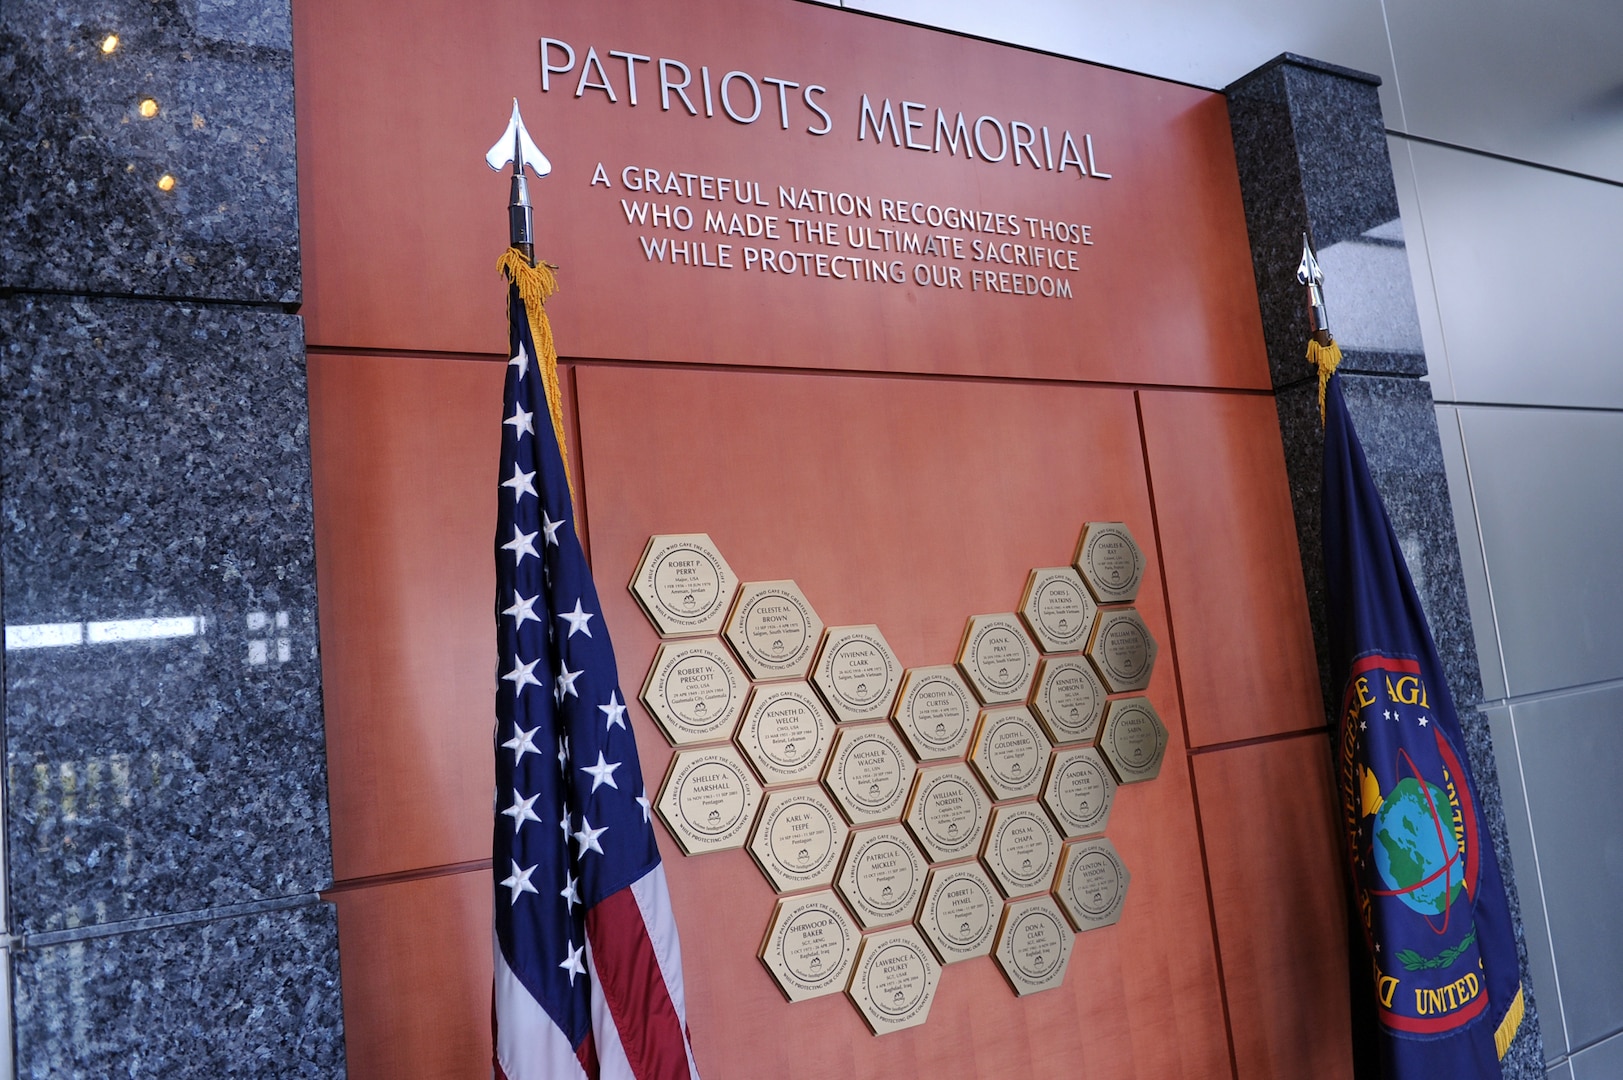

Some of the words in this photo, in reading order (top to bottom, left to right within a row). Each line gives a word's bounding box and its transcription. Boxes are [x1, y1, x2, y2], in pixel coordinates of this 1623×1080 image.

[540, 37, 833, 135] PATRIOTS
[858, 93, 1112, 179] MEMORIAL
[591, 162, 611, 188] A
[621, 165, 769, 206] GRATEFUL
[779, 185, 872, 218] NATION
[880, 198, 1020, 236] RECOGNIZES
[1024, 217, 1093, 246] THOSE
[620, 198, 694, 231] WHO
[704, 209, 780, 239] MADE
[788, 218, 840, 246] THE
[847, 225, 965, 259] ULTIMATE
[972, 240, 1080, 271] SACRIFICE
[639, 236, 733, 268] WHILE
[743, 247, 906, 283] PROTECTING
[914, 263, 963, 289] OUR
[972, 269, 1073, 299] FREEDOM
[680, 674, 714, 683] PRESCOTT
[767, 709, 797, 717] KENNETH
[999, 732, 1018, 741] JUDITH
[994, 739, 1030, 749] GOLDENBERG
[853, 751, 880, 759] MICHAEL
[858, 758, 885, 766] WAGNER
[692, 775, 720, 783] SHELLEY
[1072, 778, 1090, 786] FOSTER
[693, 783, 730, 793] MARSHALL
[933, 791, 957, 799] WILLIAM
[935, 797, 963, 807] NORDEEN
[792, 823, 809, 831] TEEPE
[1014, 835, 1033, 843] CHAPA
[866, 852, 893, 862] PATRICIA
[871, 860, 897, 870] MICKLEY
[947, 889, 969, 898] ROBERT
[952, 898, 971, 906] HYMEL
[790, 920, 827, 933] SHERWOOD
[802, 929, 824, 938] BAKER
[875, 956, 908, 967] LAWRENCE
[884, 964, 908, 973] ROUKEY
[1415, 972, 1479, 1015] UNITED
